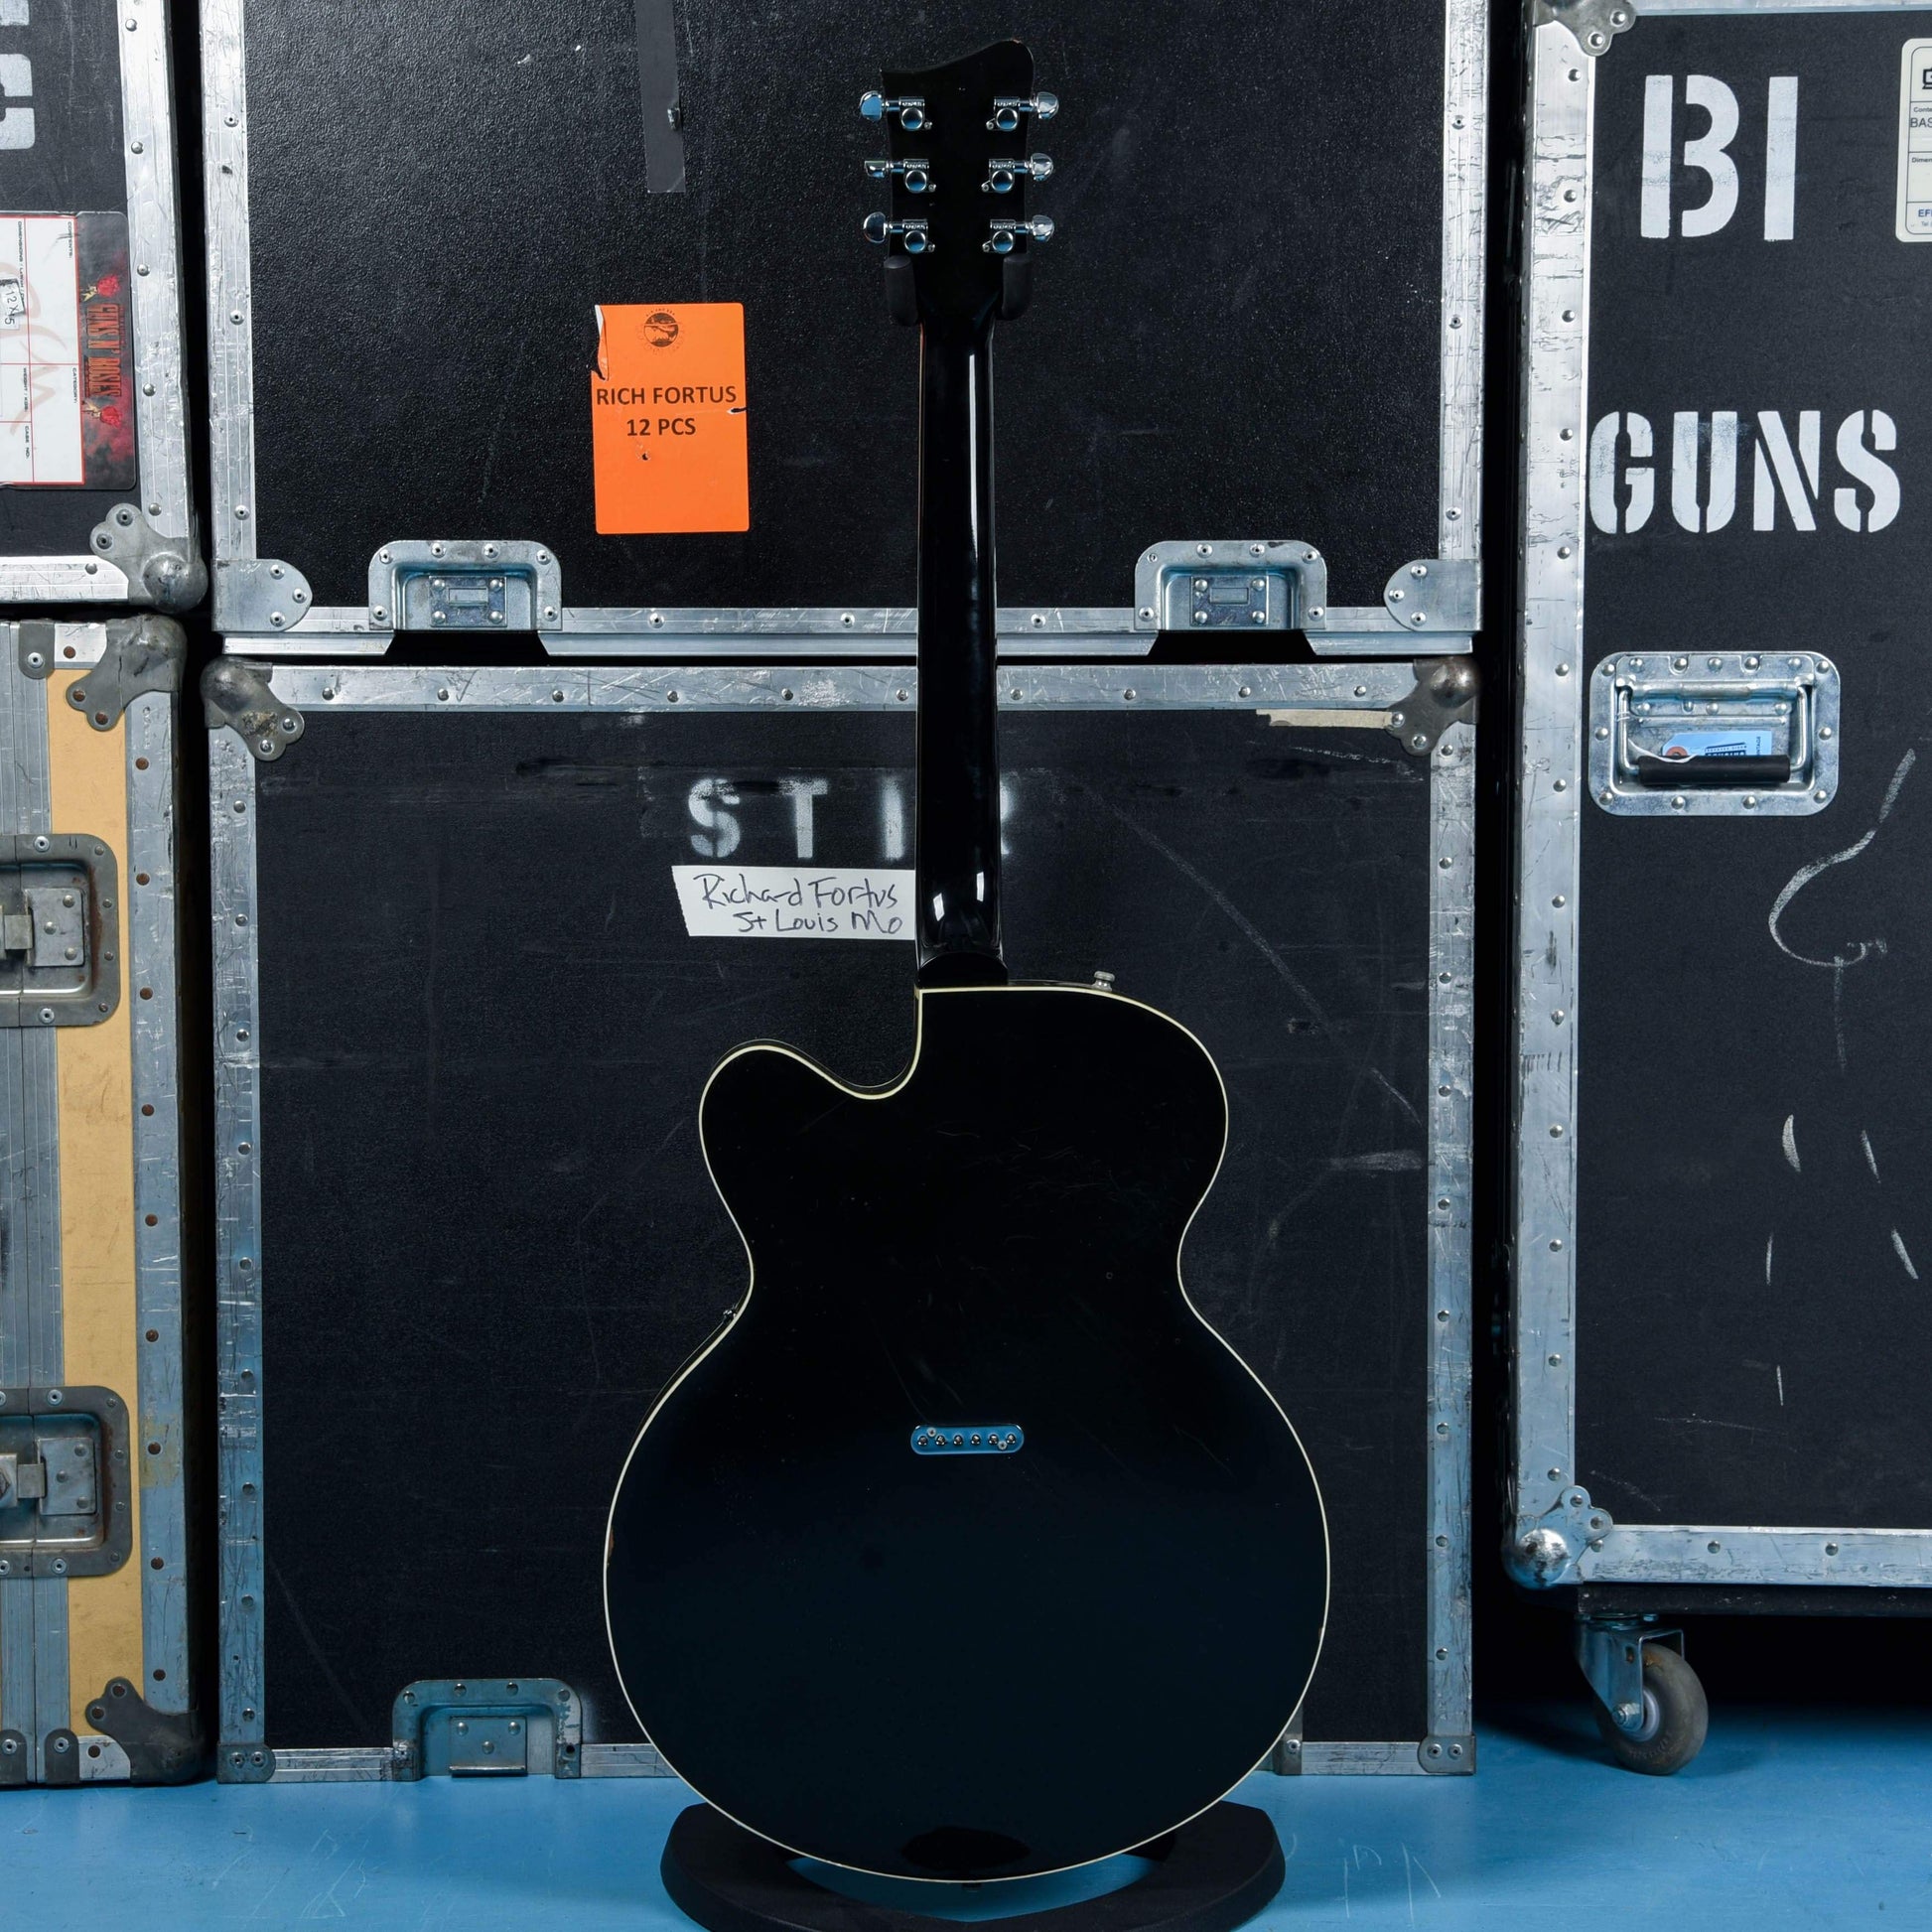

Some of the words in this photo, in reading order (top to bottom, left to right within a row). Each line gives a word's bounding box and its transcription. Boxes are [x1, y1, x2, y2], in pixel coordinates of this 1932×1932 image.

[1640, 74, 1798, 240] BI
[1918, 208, 1932, 217] EF
[86, 303, 121, 337] GUNS
[88, 357, 121, 397] ROSES
[597, 387, 645, 405] RICH
[653, 385, 737, 404] FORTUS
[626, 418, 651, 436] 12
[658, 417, 696, 436] PCS
[1589, 409, 1900, 533] GUNS
[693, 873, 804, 909] Richard
[808, 875, 898, 908] Fortus
[732, 910, 766, 933] St
[775, 908, 838, 933] Louis
